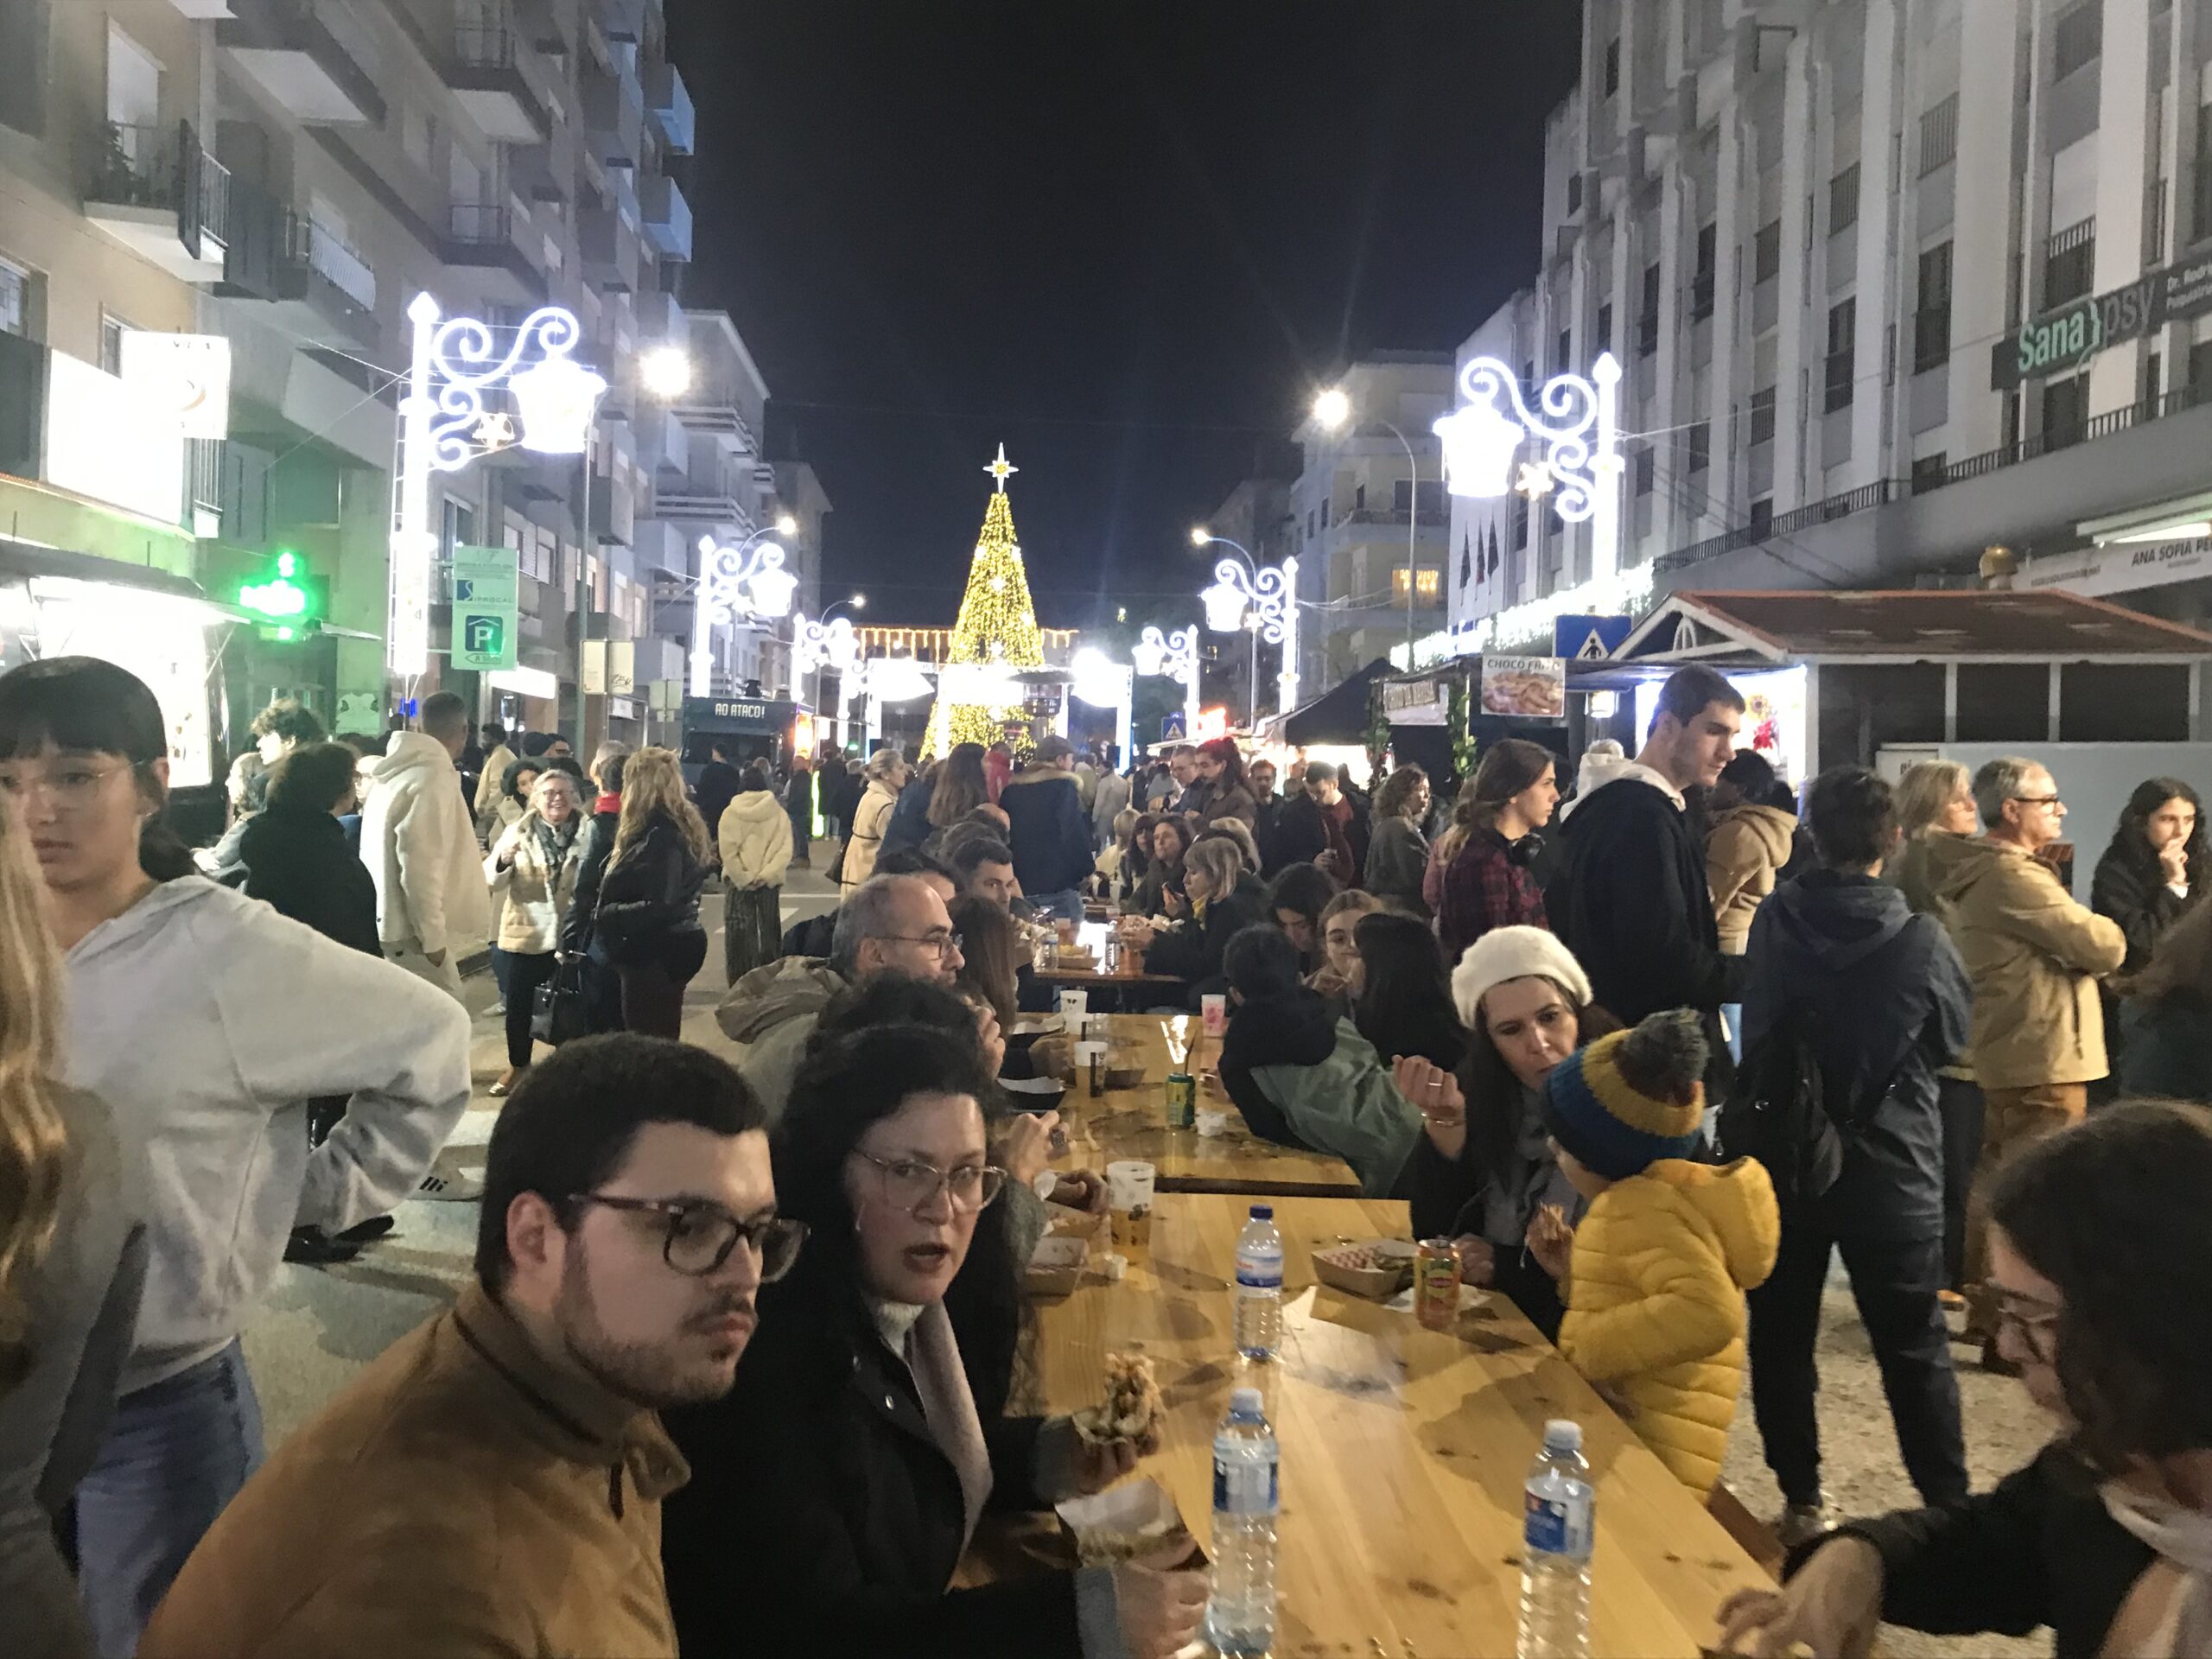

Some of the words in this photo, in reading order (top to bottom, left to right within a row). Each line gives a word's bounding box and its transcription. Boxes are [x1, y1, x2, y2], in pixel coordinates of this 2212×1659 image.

[2131, 548, 2156, 567] ANA
[2158, 539, 2192, 562] SOFIA
[1487, 658, 1525, 670] CHOCO
[715, 702, 728, 716] AO
[730, 703, 766, 719] ATACO!
